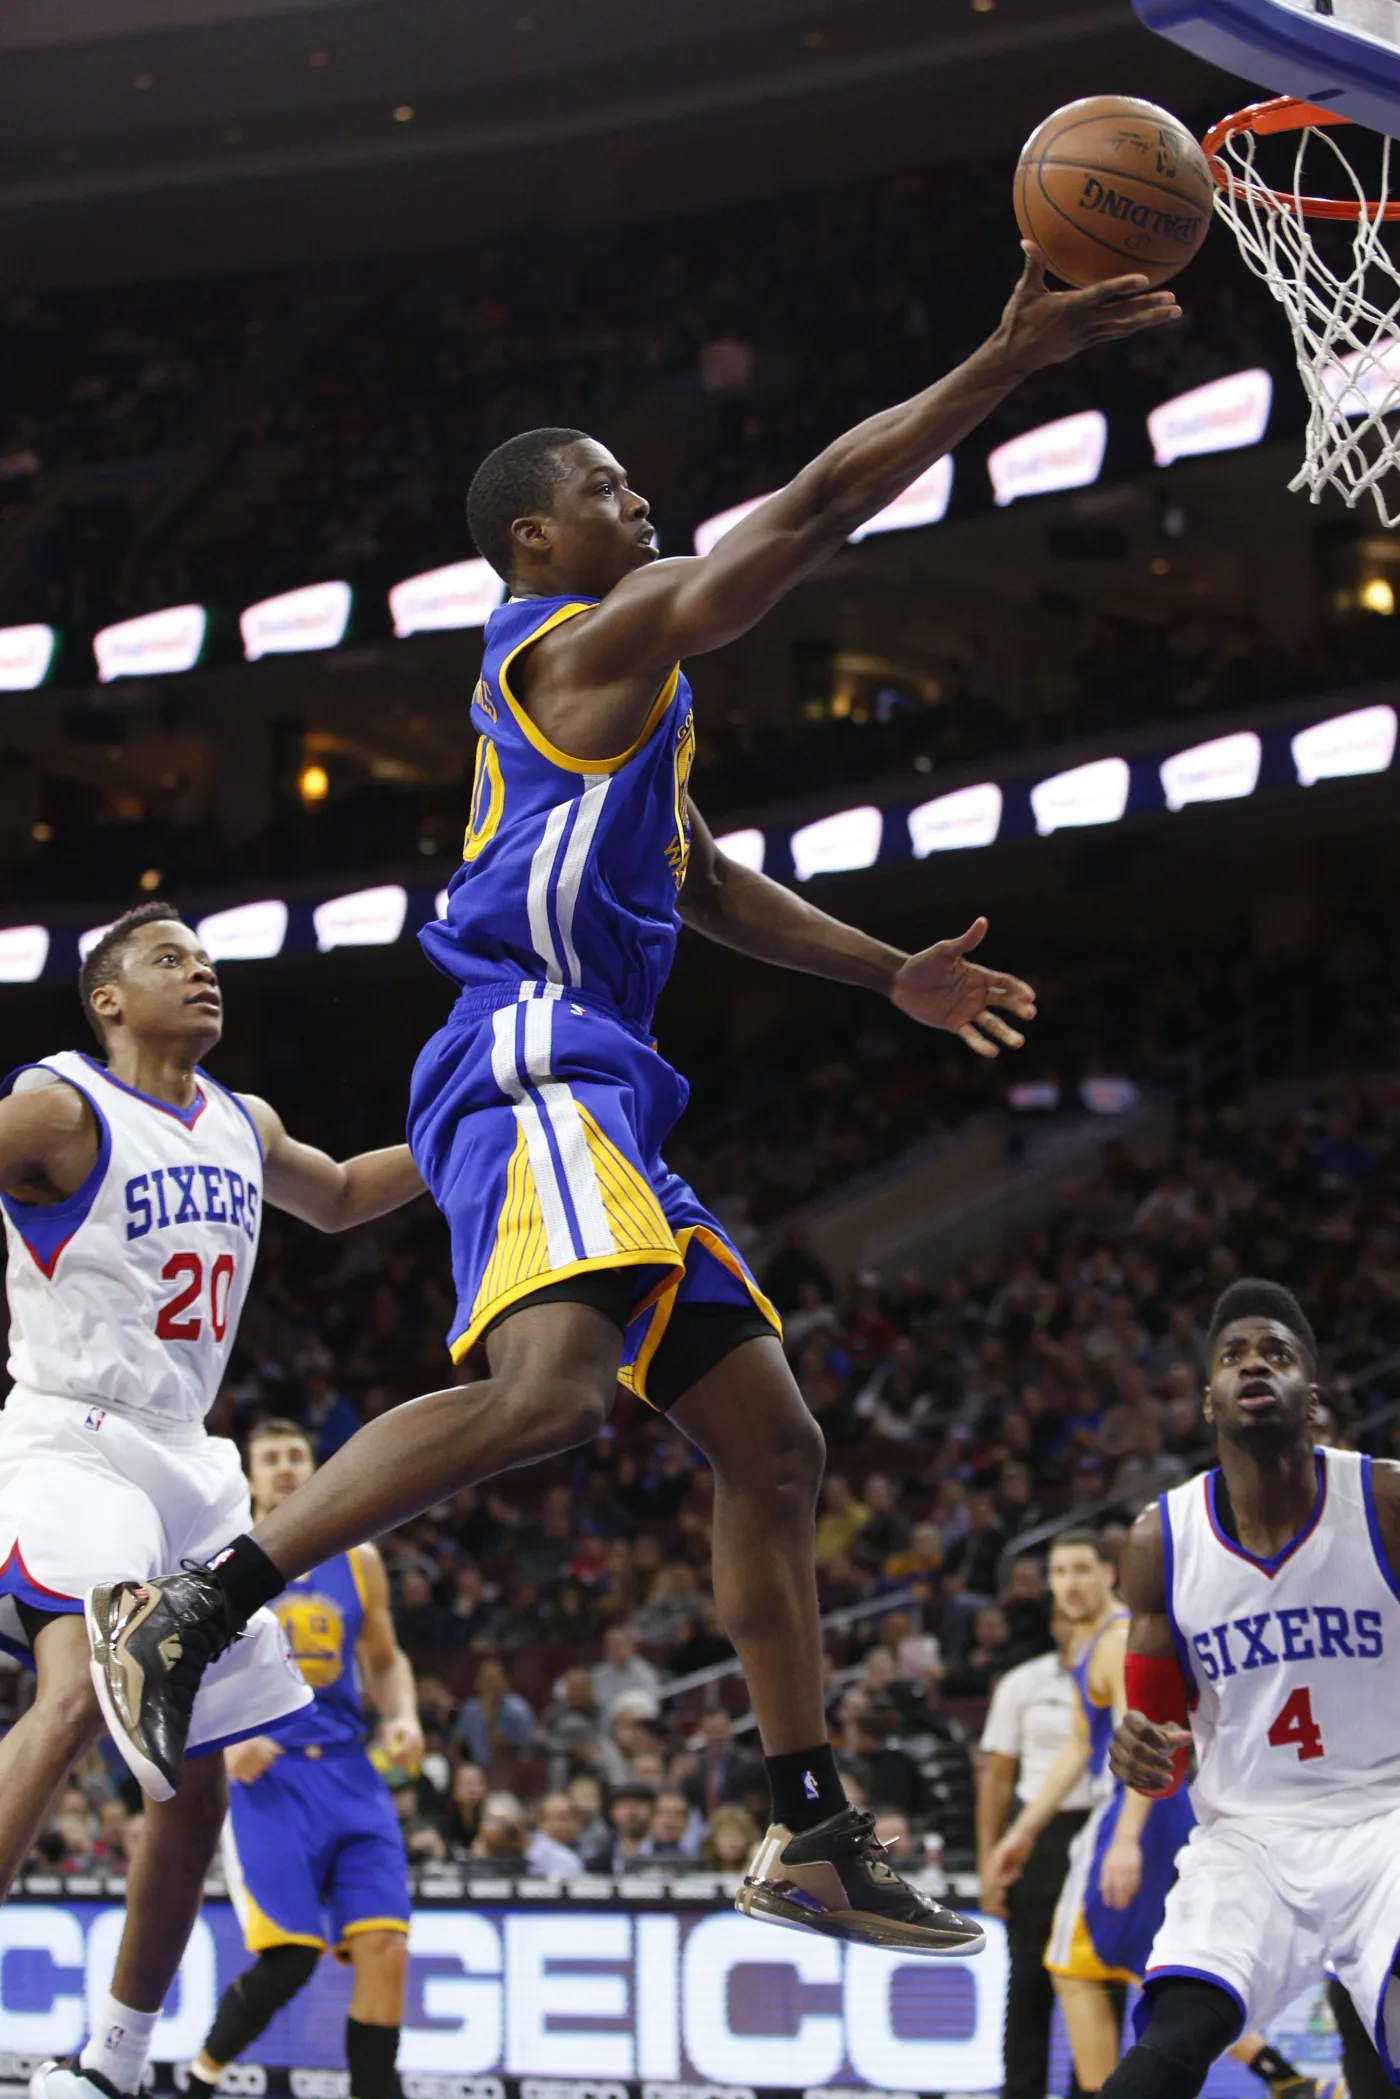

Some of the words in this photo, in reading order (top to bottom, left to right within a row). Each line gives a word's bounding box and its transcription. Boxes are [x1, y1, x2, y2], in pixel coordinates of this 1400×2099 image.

[125, 1165, 258, 1244] SIXERS
[154, 1252, 235, 1342] 20
[1192, 1606, 1384, 1681] SIXERS
[1267, 1686, 1325, 1761] 4
[396, 1910, 1010, 2093] GEICO
